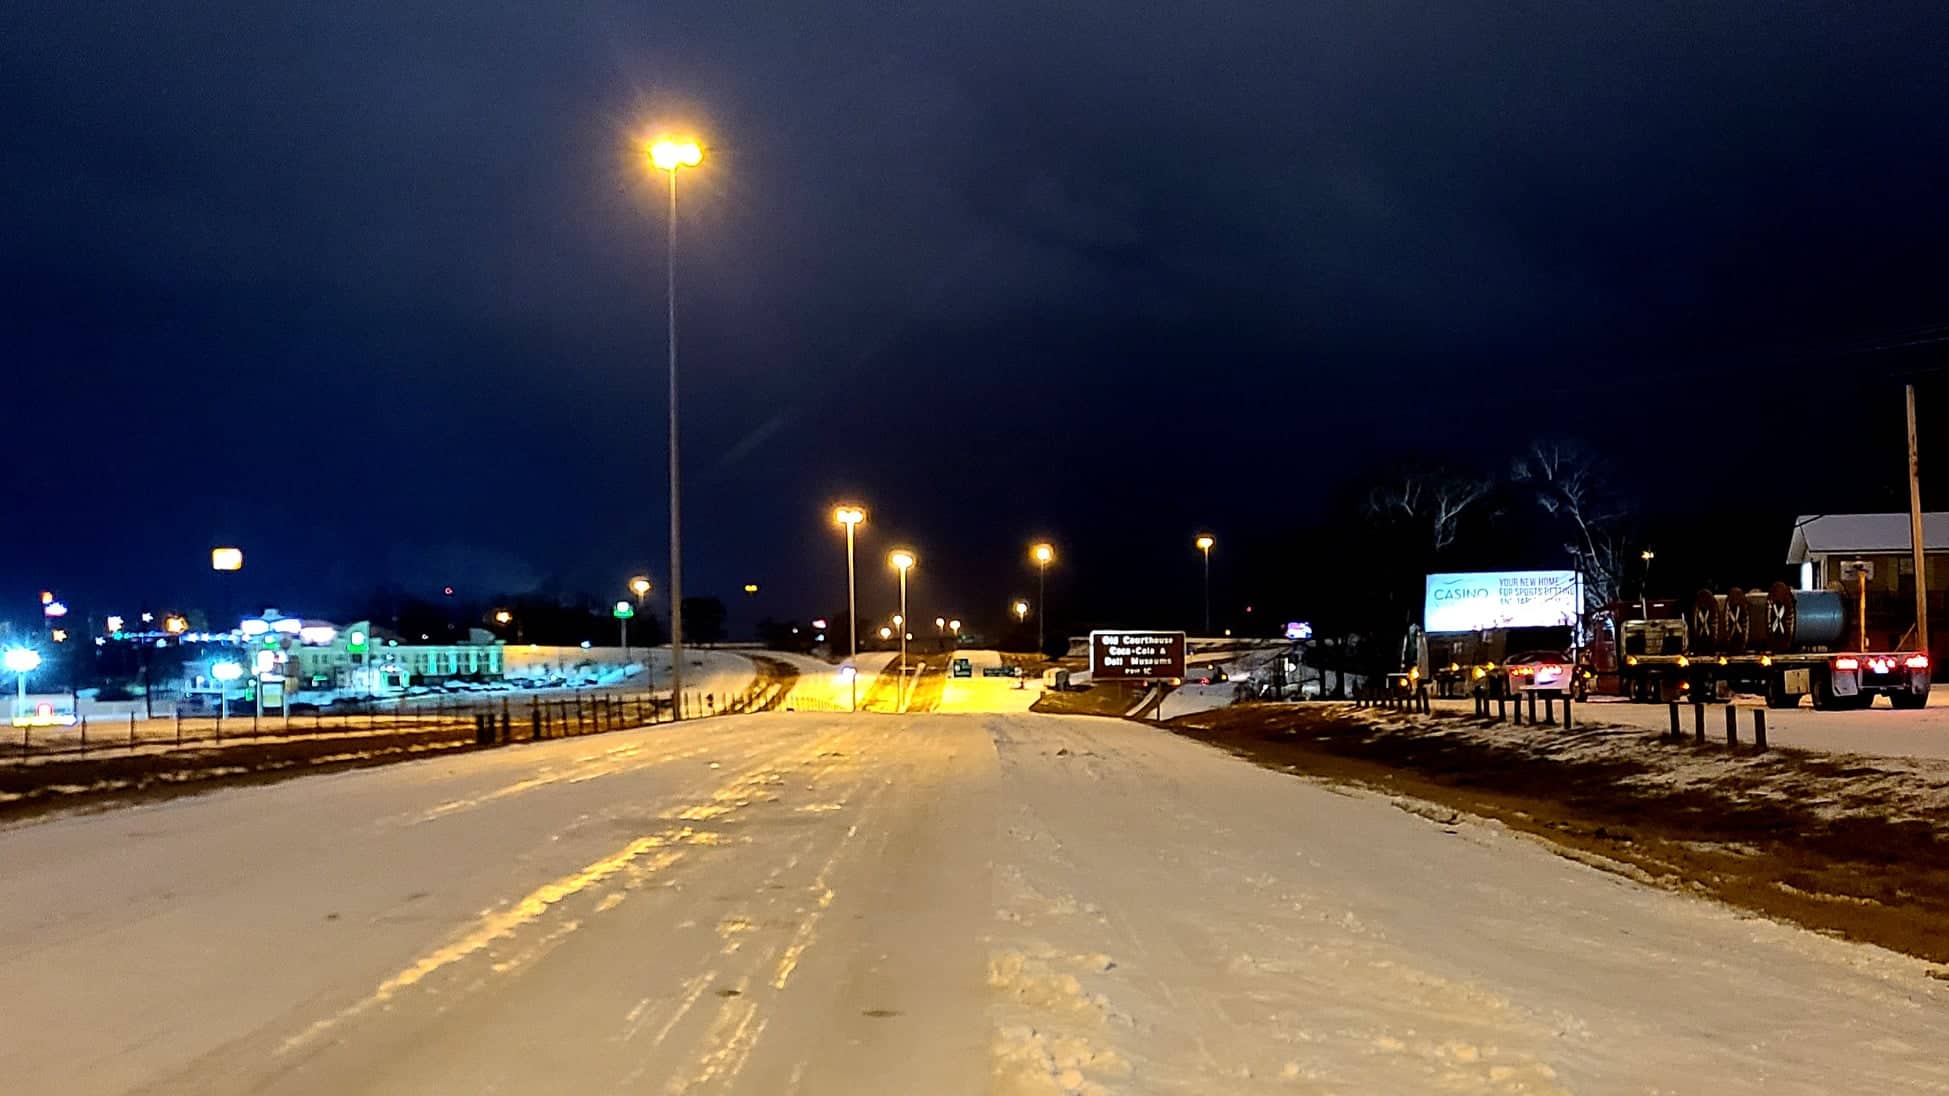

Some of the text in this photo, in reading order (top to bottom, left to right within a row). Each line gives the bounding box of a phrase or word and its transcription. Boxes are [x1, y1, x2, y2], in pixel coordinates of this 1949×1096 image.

[1499, 578, 1519, 587] YOUR
[1520, 577, 1537, 586] NEW
[1434, 588, 1489, 600] CASINO
[1499, 588, 1513, 597] FOR
[1102, 636, 1173, 645] Old Courthouse
[1109, 646, 1155, 655] Coca-Cola
[1104, 657, 1172, 666] Doll Museums
